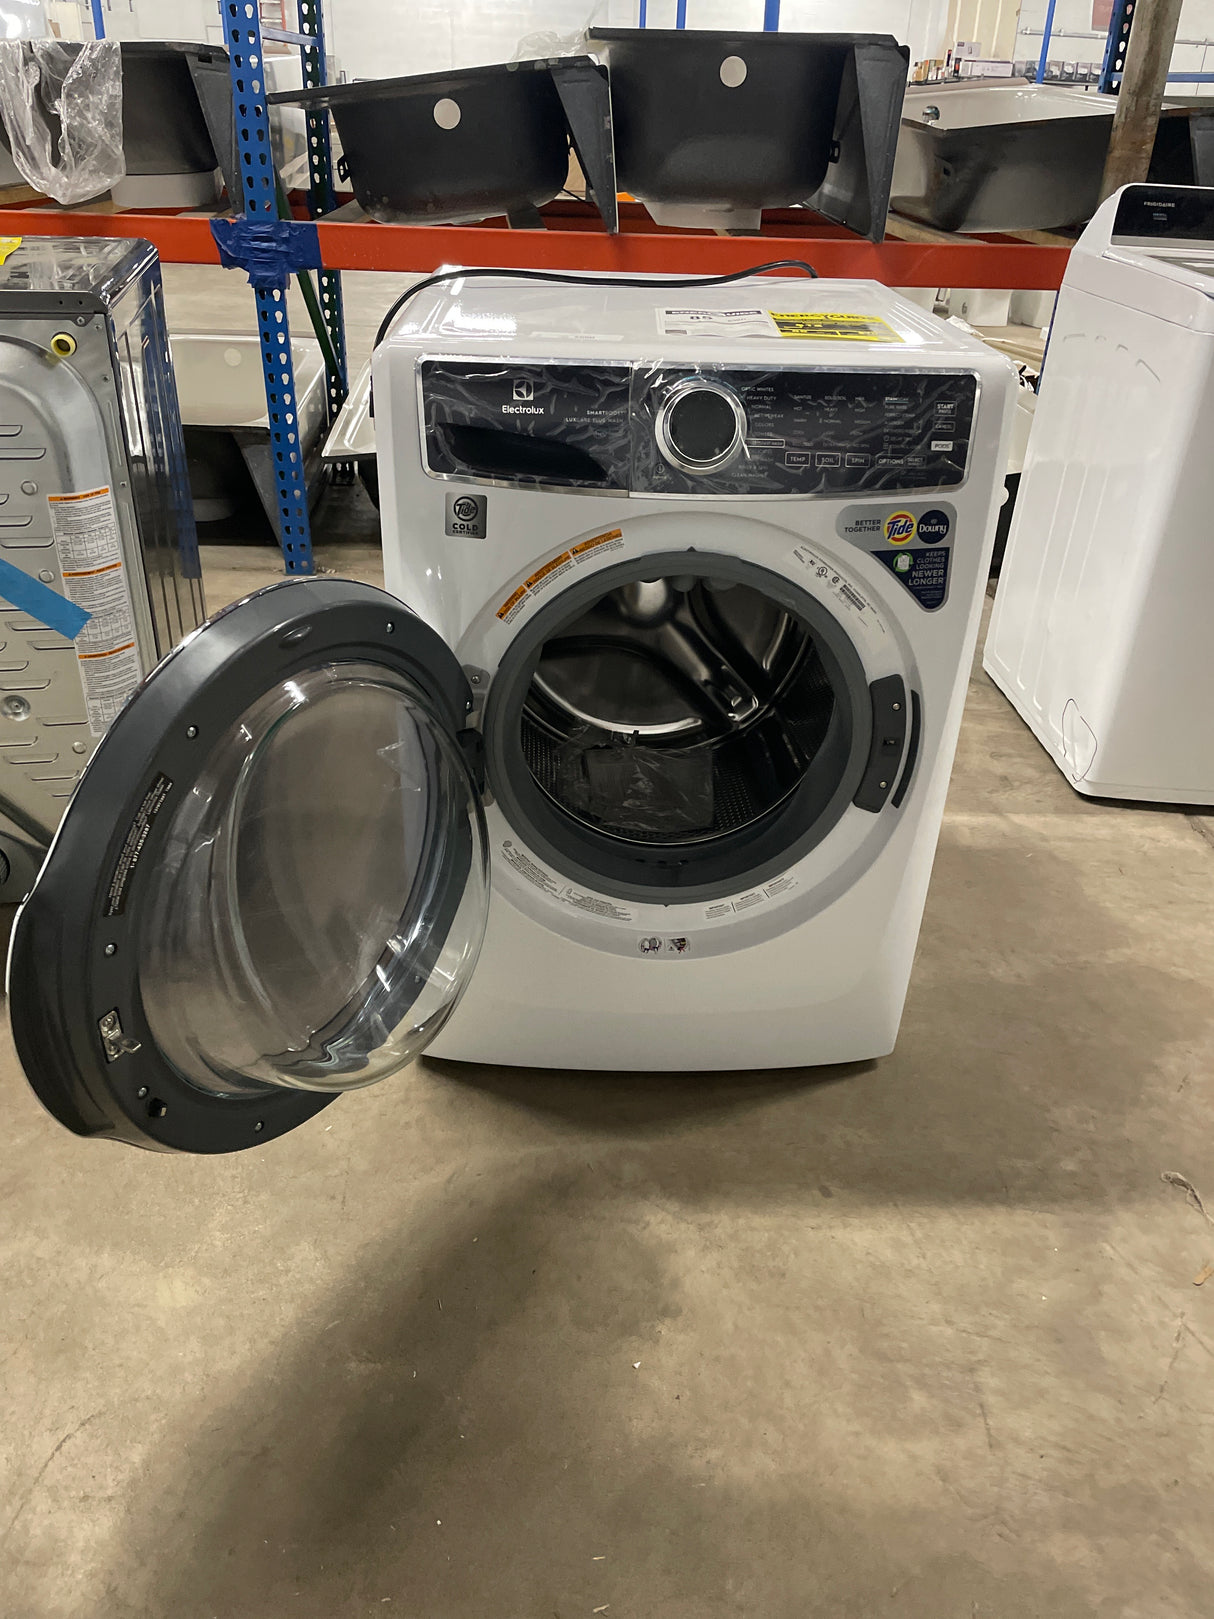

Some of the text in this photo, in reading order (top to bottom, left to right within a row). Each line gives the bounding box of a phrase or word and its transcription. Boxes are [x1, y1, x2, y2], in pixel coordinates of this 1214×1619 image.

[502, 405, 545, 415] Electrolux
[456, 501, 476, 516] Tide
[452, 522, 479, 531] COLD
[844, 525, 881, 533] TOGETHER
[886, 519, 915, 540] Tide
[919, 523, 947, 534] Downy
[911, 569, 945, 578] NEWER
[908, 577, 945, 586] LONGER
